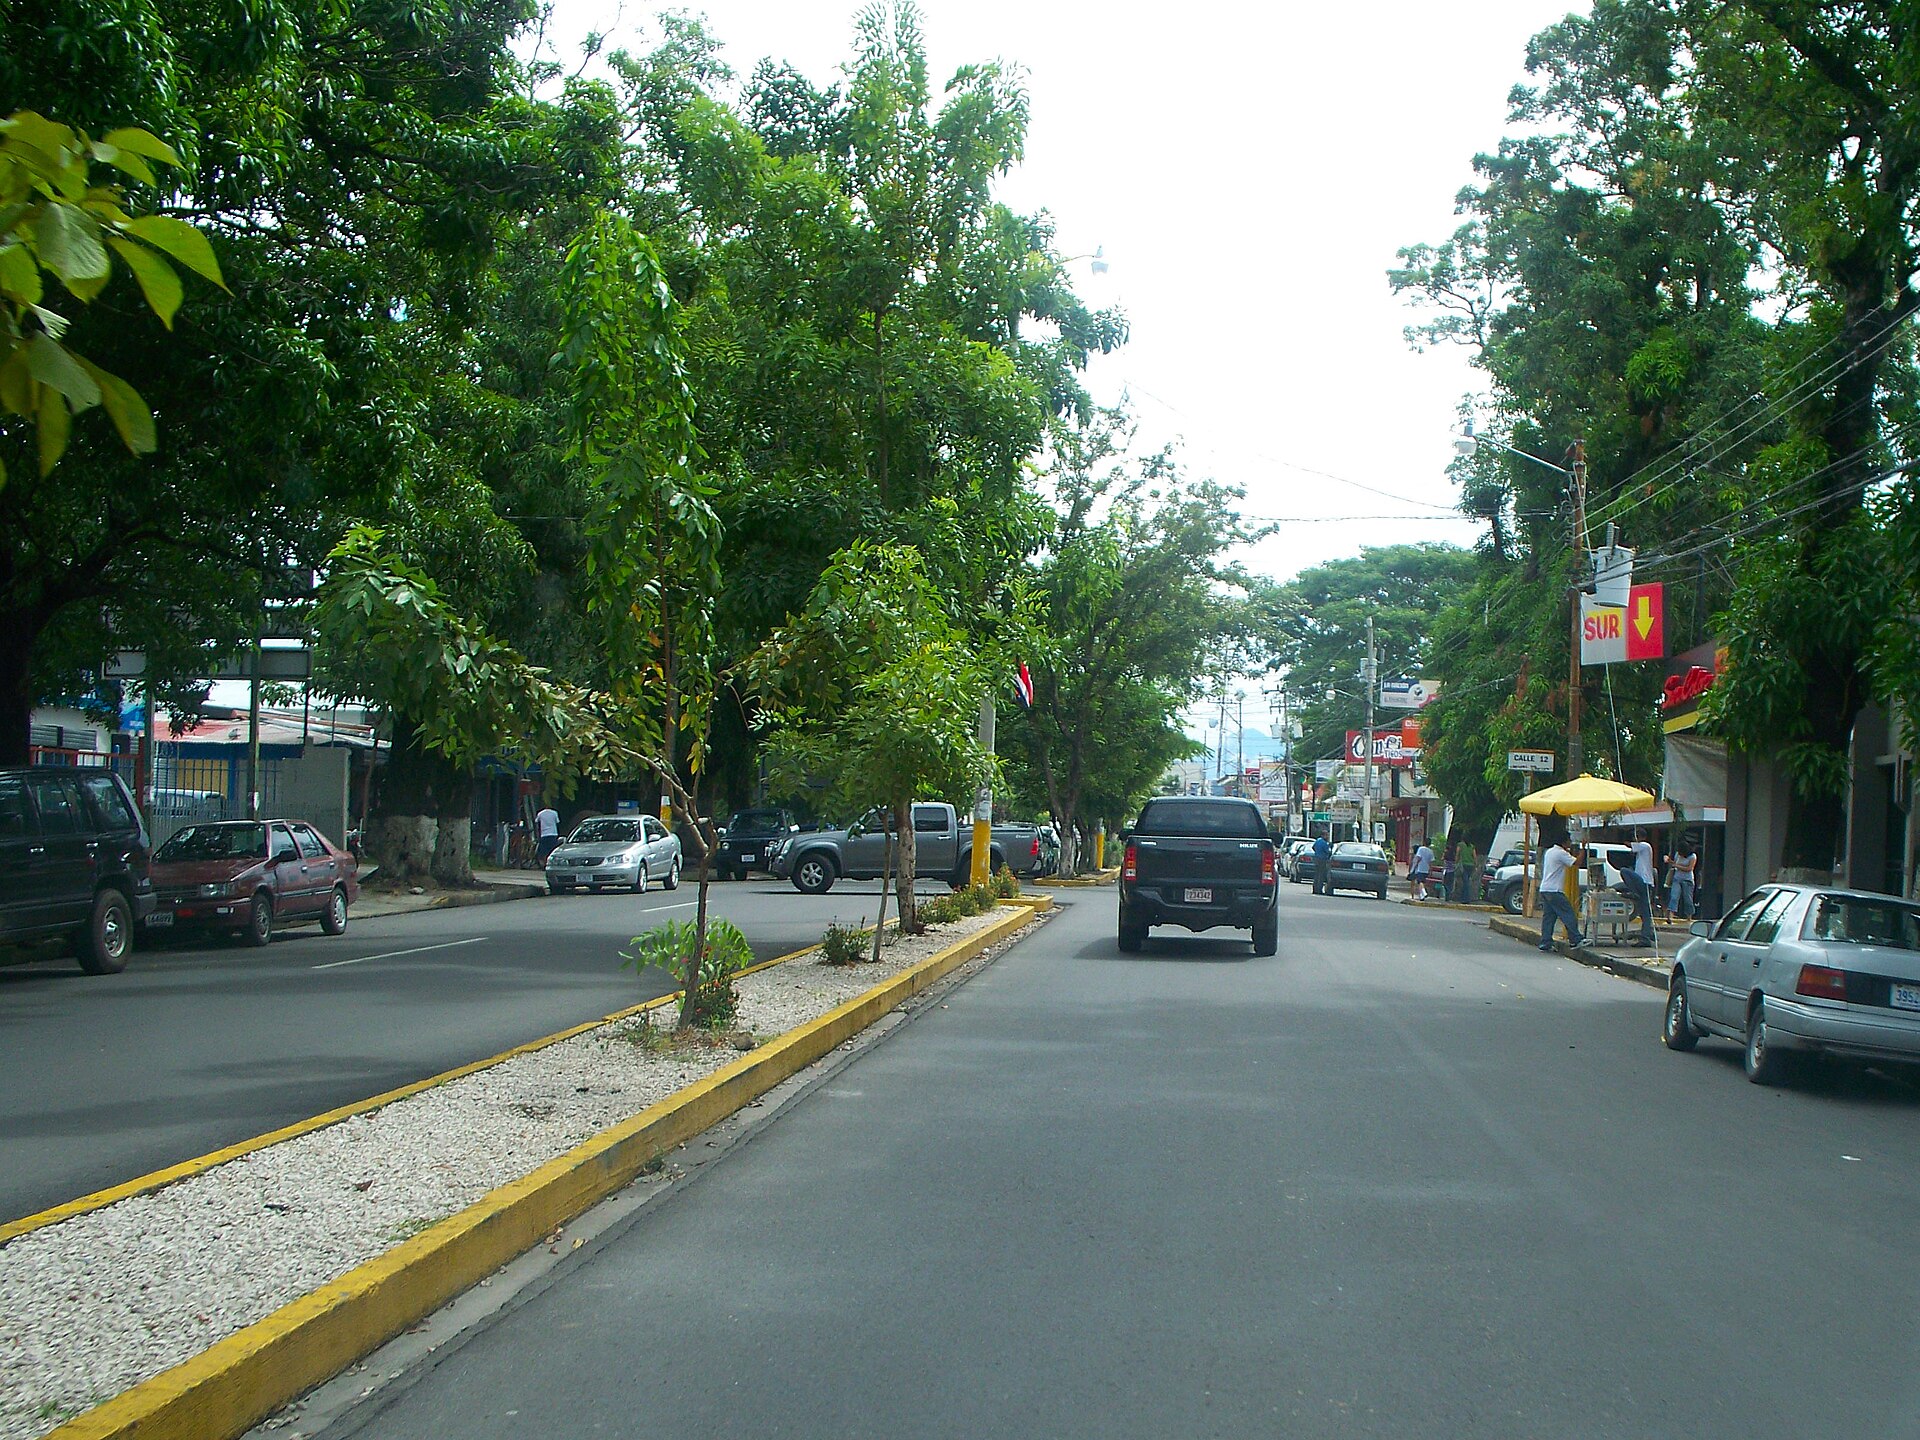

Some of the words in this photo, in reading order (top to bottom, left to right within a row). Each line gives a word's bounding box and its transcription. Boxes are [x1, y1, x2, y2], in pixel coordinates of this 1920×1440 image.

[1584, 613, 1619, 641] SUR
[1513, 754, 1536, 762] CALLE
[1540, 755, 1549, 763] 12
